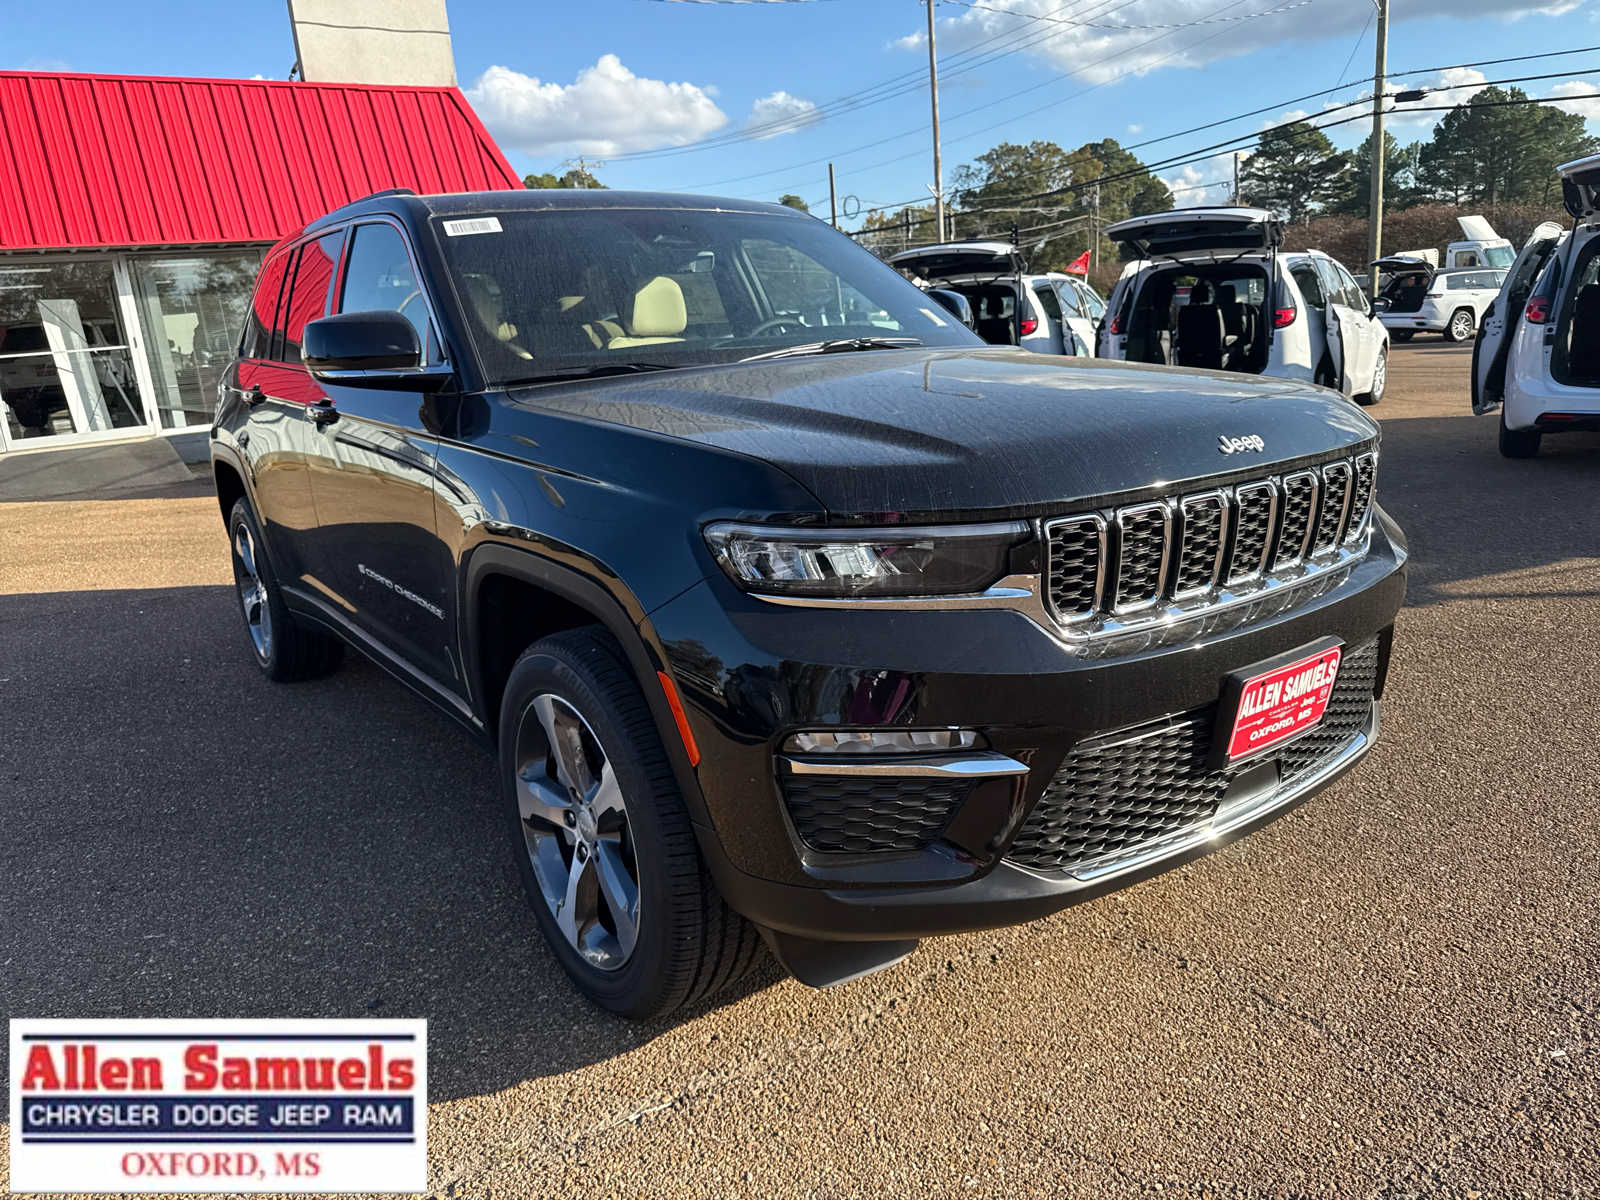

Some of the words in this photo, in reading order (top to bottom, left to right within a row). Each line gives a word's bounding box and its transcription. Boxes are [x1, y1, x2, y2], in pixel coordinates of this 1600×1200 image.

[1219, 434, 1265, 454] Jeep
[1239, 680, 1283, 720] ALLEN
[1283, 659, 1337, 702] SAMUELS
[1249, 716, 1295, 741] OXFORD,
[1297, 707, 1312, 721] MS
